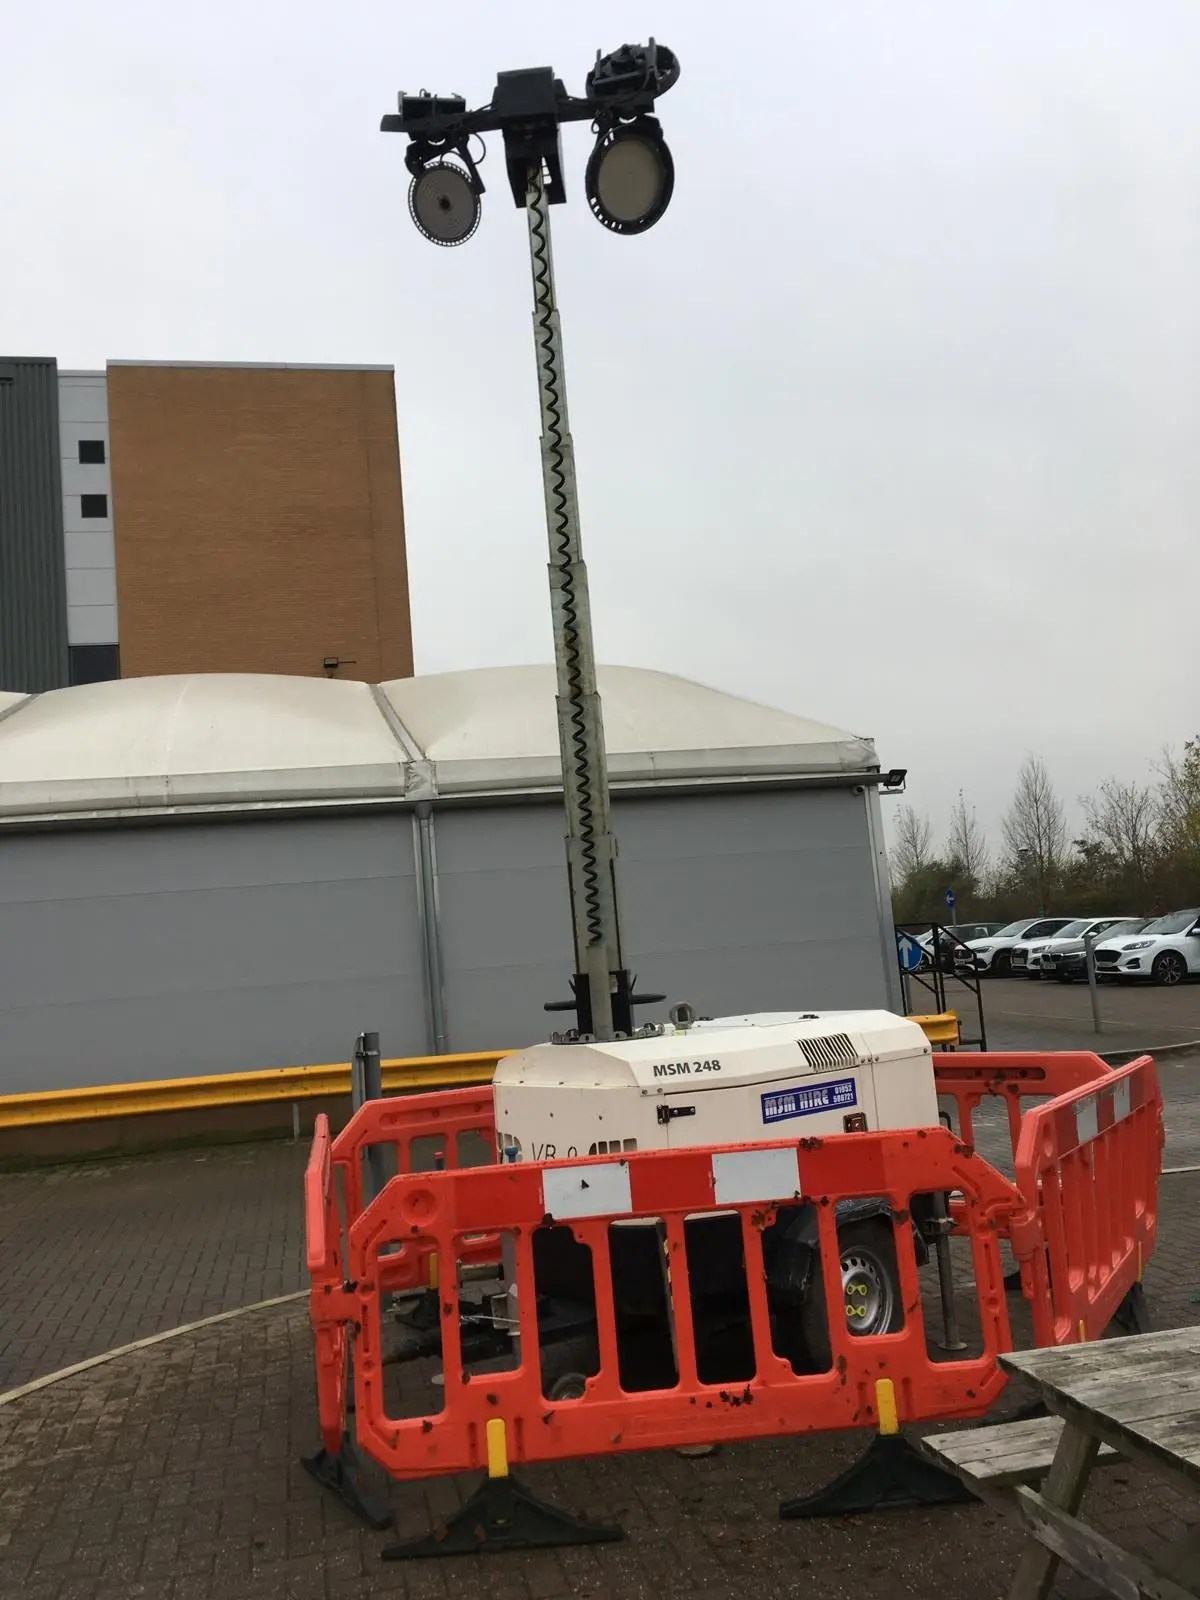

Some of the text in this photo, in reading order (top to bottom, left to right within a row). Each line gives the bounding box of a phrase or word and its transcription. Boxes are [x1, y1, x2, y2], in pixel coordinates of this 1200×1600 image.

[653, 1060, 721, 1077] MSM 248
[799, 1088, 829, 1109] HIRE
